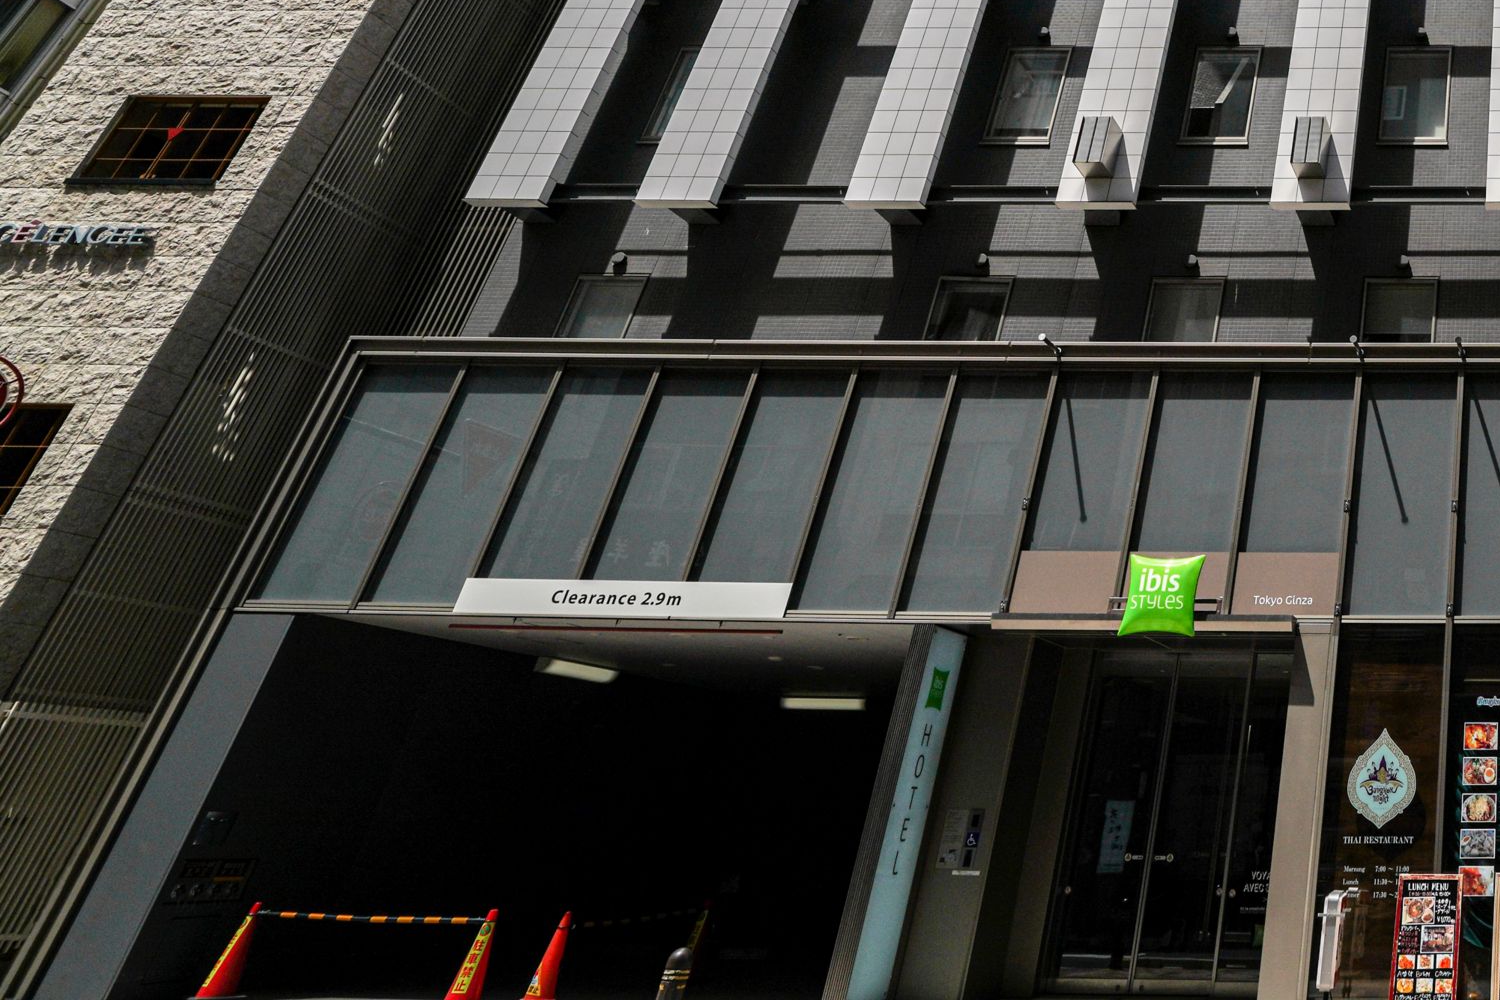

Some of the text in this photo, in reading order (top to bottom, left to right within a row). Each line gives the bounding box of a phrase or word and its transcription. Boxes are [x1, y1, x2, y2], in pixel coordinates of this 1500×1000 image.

[1138, 568, 1181, 592] ibis
[551, 589, 682, 606] Clearance 2.9m
[1253, 595, 1313, 606] Tokyo Ginza
[892, 723, 933, 876] HOTEL
[1343, 836, 1414, 844] THAI RESTAURANT
[1375, 865, 1387, 873] 7:00
[1395, 865, 1410, 873] 11:00
[1342, 878, 1359, 886] Lunch
[1408, 882, 1429, 891] LUNCH
[1431, 882, 1449, 891] MENU
[1243, 883, 1264, 893] AVEC
[454, 939, 486, 992] 駐車禁止
